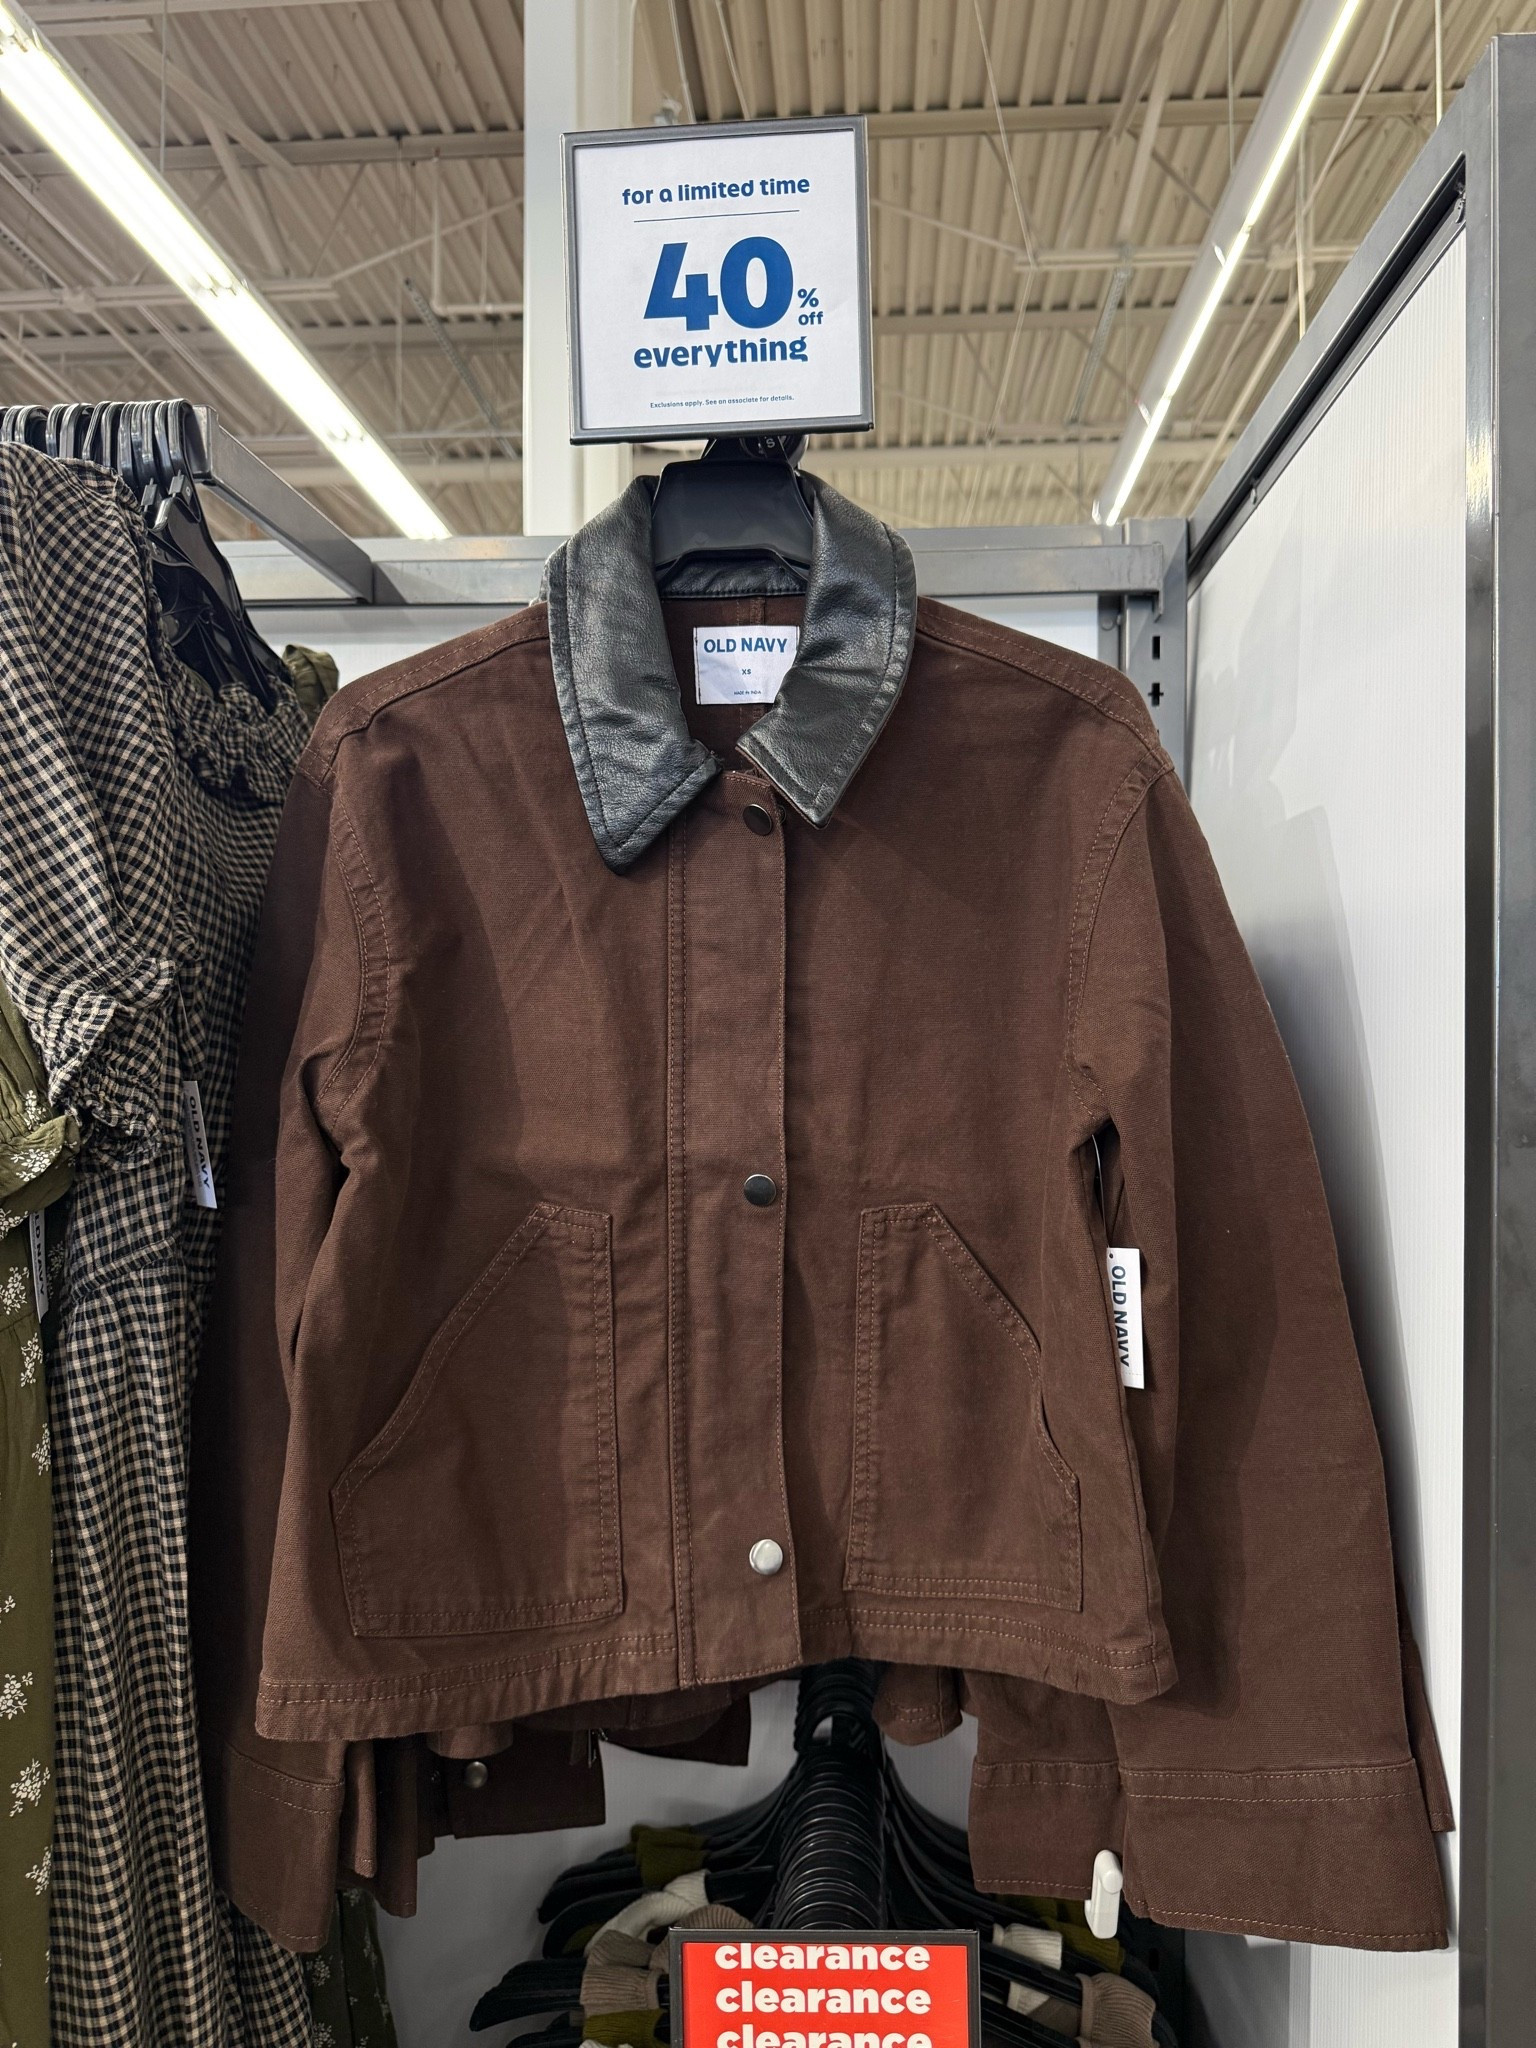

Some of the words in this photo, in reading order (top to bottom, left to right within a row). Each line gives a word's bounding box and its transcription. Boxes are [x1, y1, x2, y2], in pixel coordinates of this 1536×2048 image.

[622, 189, 653, 205] for
[659, 188, 673, 202] a
[678, 180, 754, 201] limited
[760, 178, 810, 196] time
[643, 236, 794, 332] 40
[797, 288, 820, 309] %
[798, 311, 824, 326] off
[633, 336, 808, 369] everything
[650, 401, 684, 409] Exclusions
[684, 400, 704, 408] apply.
[770, 394, 795, 402] details.
[703, 638, 737, 653] OLD
[741, 637, 788, 653] NAVY
[189, 1095, 200, 1133] OLD
[196, 1137, 210, 1189] NAVY
[1111, 1265, 1127, 1305] OLD
[1113, 1310, 1130, 1367] NAVY
[714, 1942, 931, 1971] clearance
[715, 1980, 932, 2014] clearance
